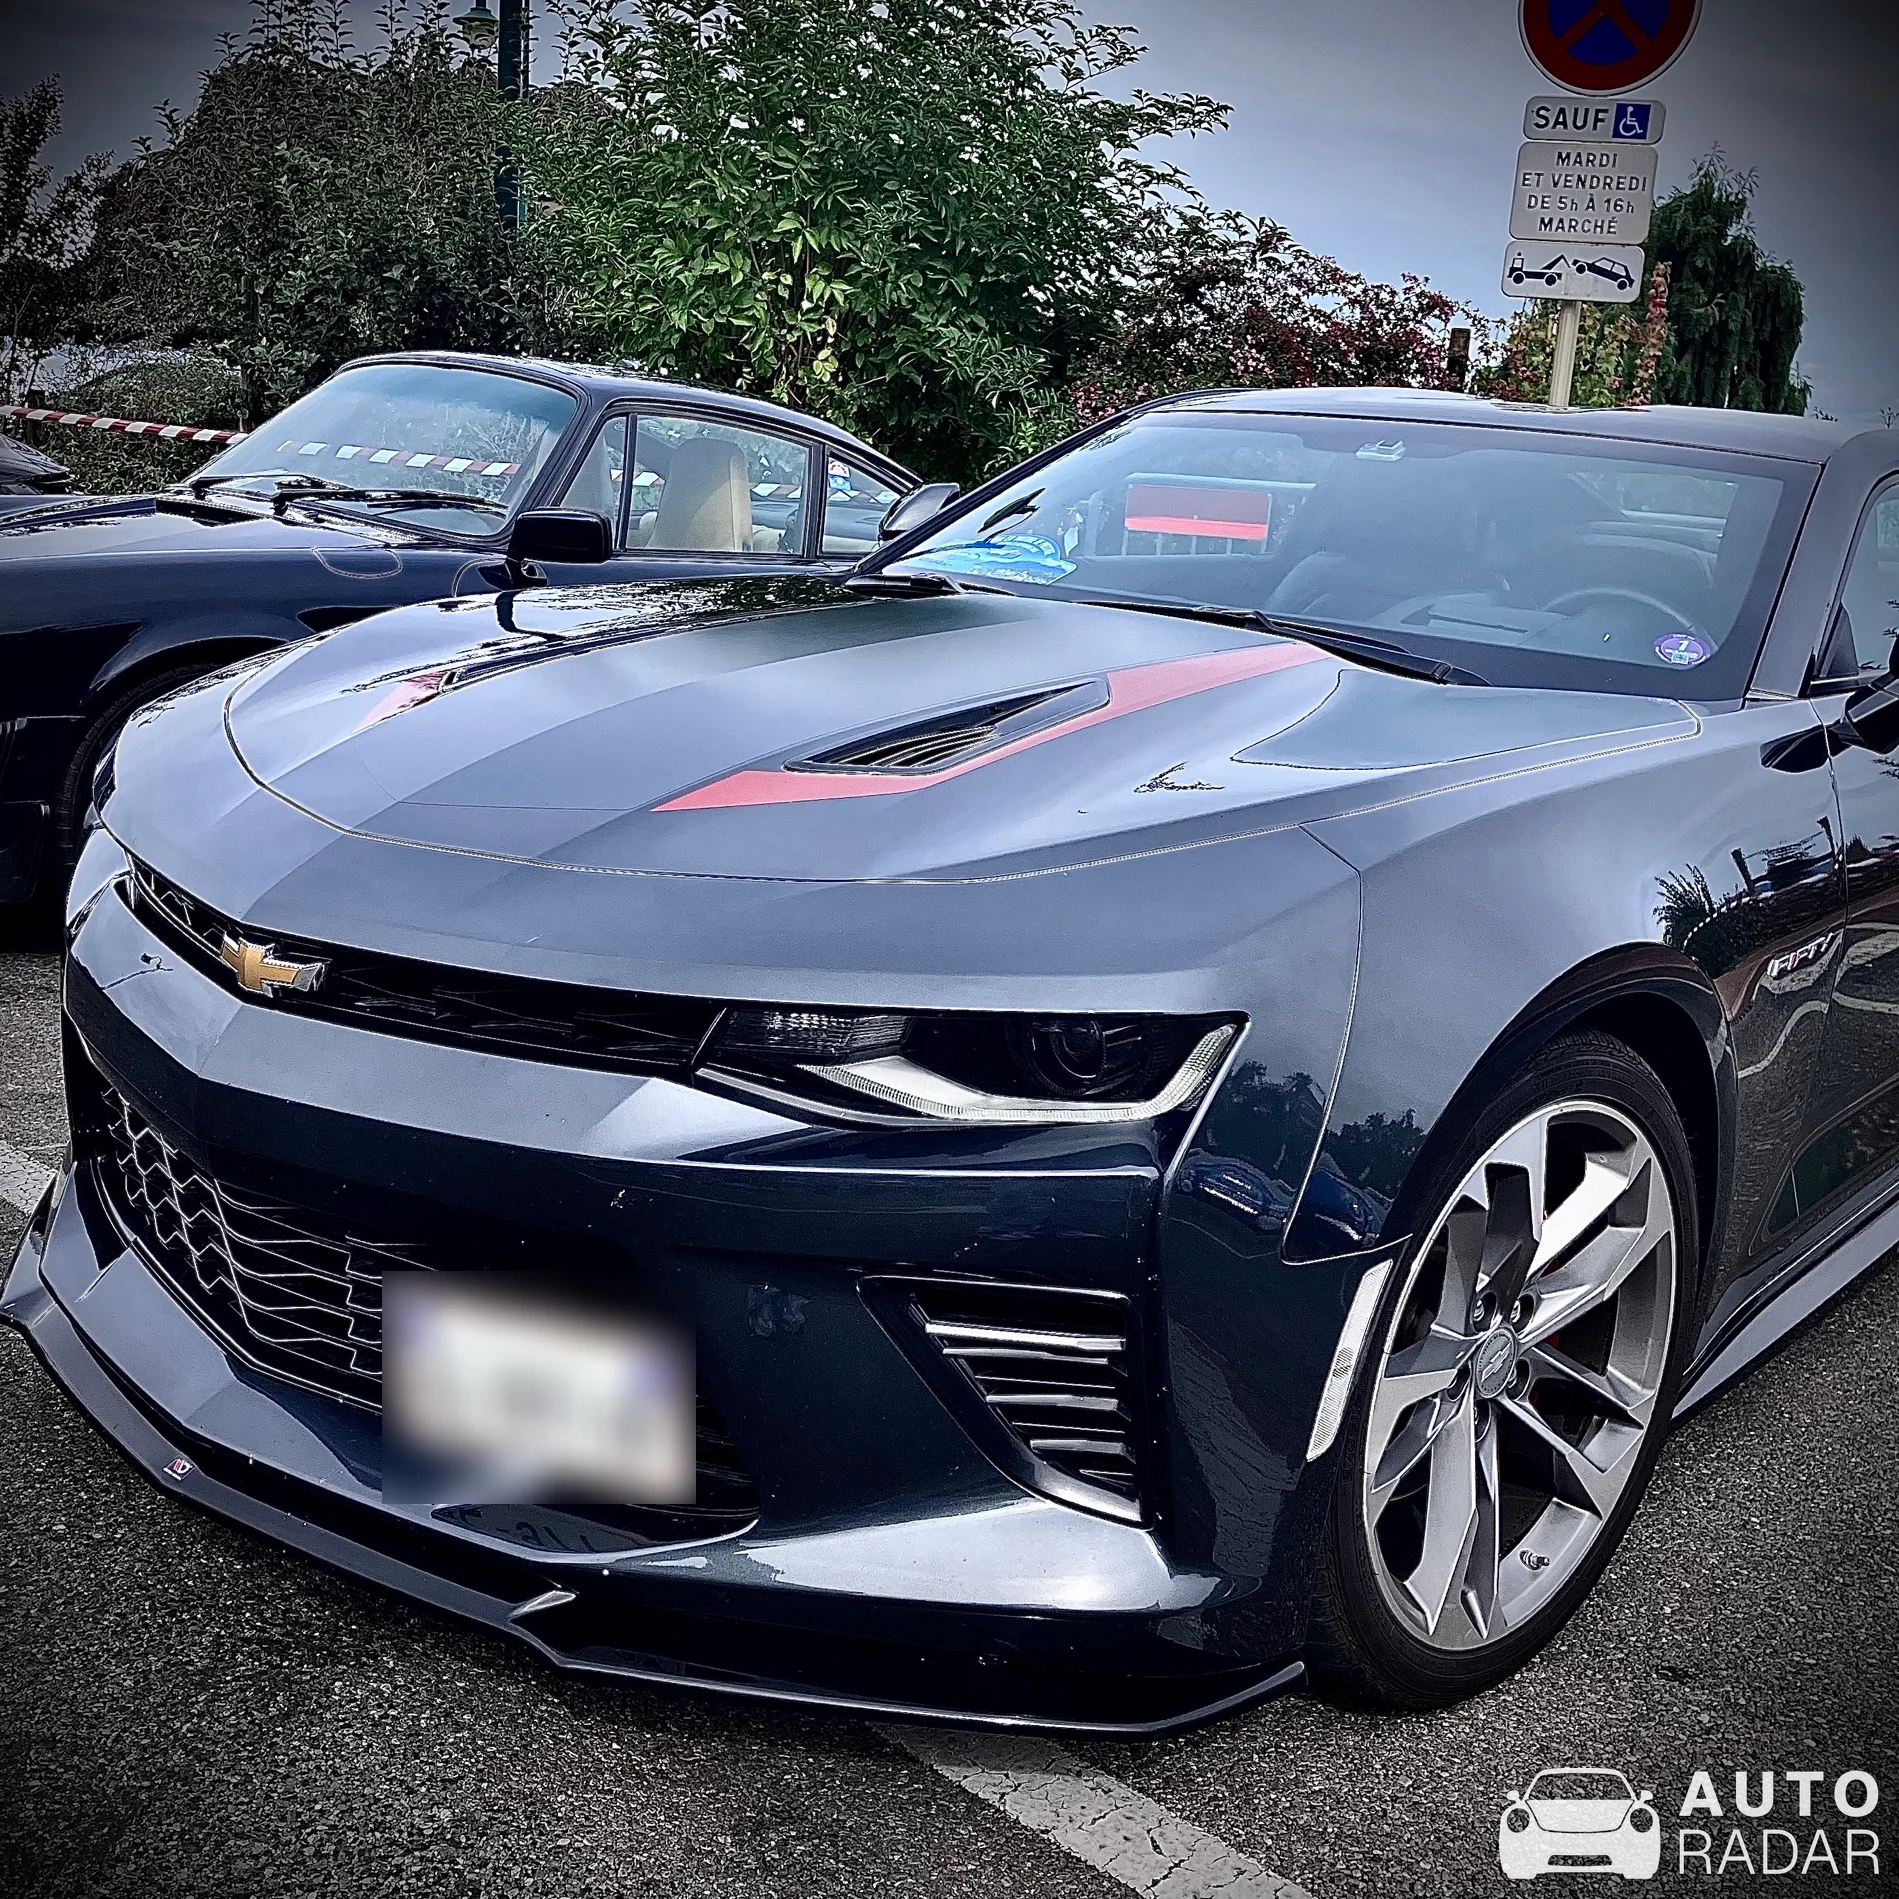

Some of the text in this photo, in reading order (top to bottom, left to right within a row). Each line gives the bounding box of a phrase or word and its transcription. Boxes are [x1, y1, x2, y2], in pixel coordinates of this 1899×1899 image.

[1532, 105, 1610, 132] SAUF
[1555, 151, 1618, 169] MARDI
[1521, 172, 1647, 192] ET VENDREDI
[1527, 193, 1635, 214] DE 5h À 16h
[1538, 216, 1618, 235] MARCHÉ
